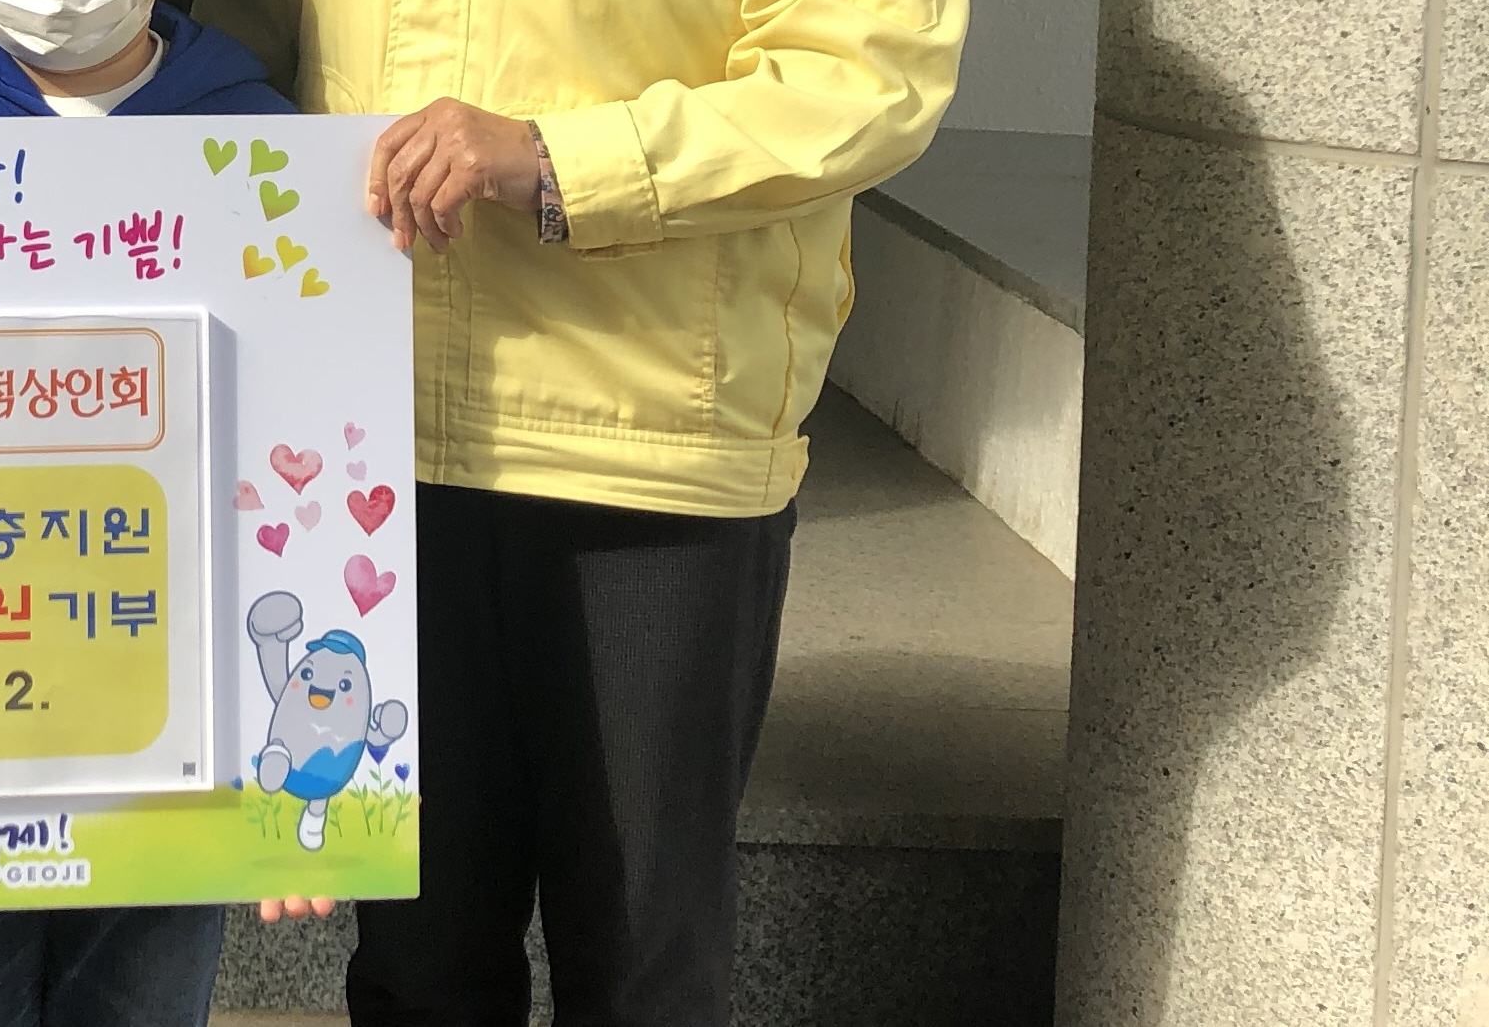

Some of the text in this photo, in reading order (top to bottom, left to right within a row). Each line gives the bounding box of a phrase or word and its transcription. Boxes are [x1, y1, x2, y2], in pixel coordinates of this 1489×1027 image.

[74, 211, 184, 279] 기쁨!
[4, 670, 50, 711] 2.
[7, 865, 85, 883] GEOJE
